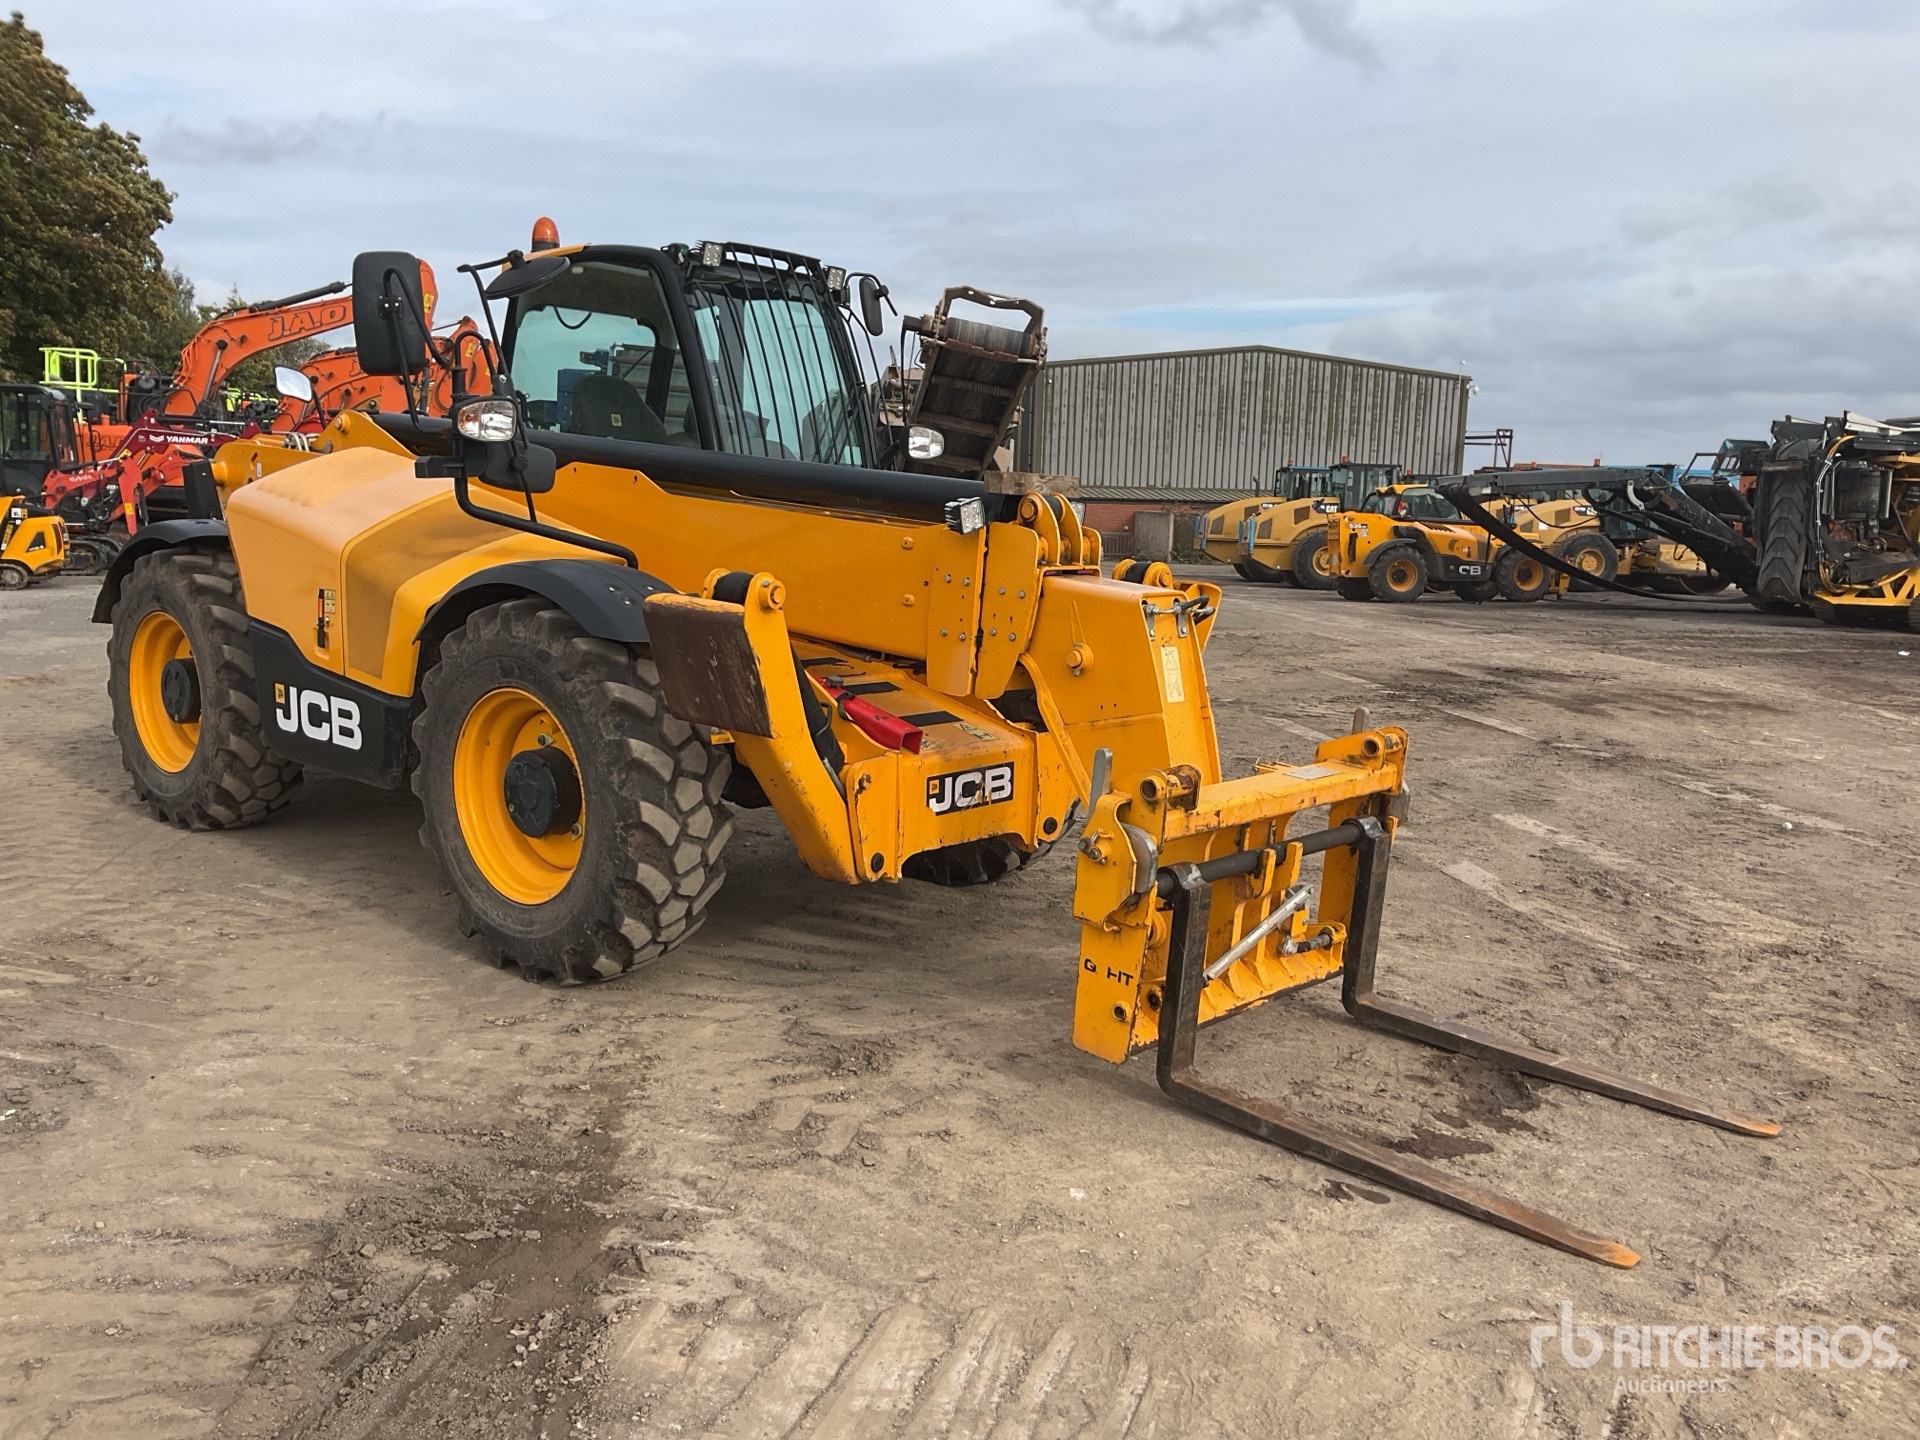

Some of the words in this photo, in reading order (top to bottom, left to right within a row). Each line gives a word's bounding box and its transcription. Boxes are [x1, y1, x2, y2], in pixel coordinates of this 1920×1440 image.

[166, 435, 209, 445] YANMAR
[1325, 505, 1338, 513] CAT
[276, 686, 362, 751] JCB
[929, 766, 1012, 813] JCB
